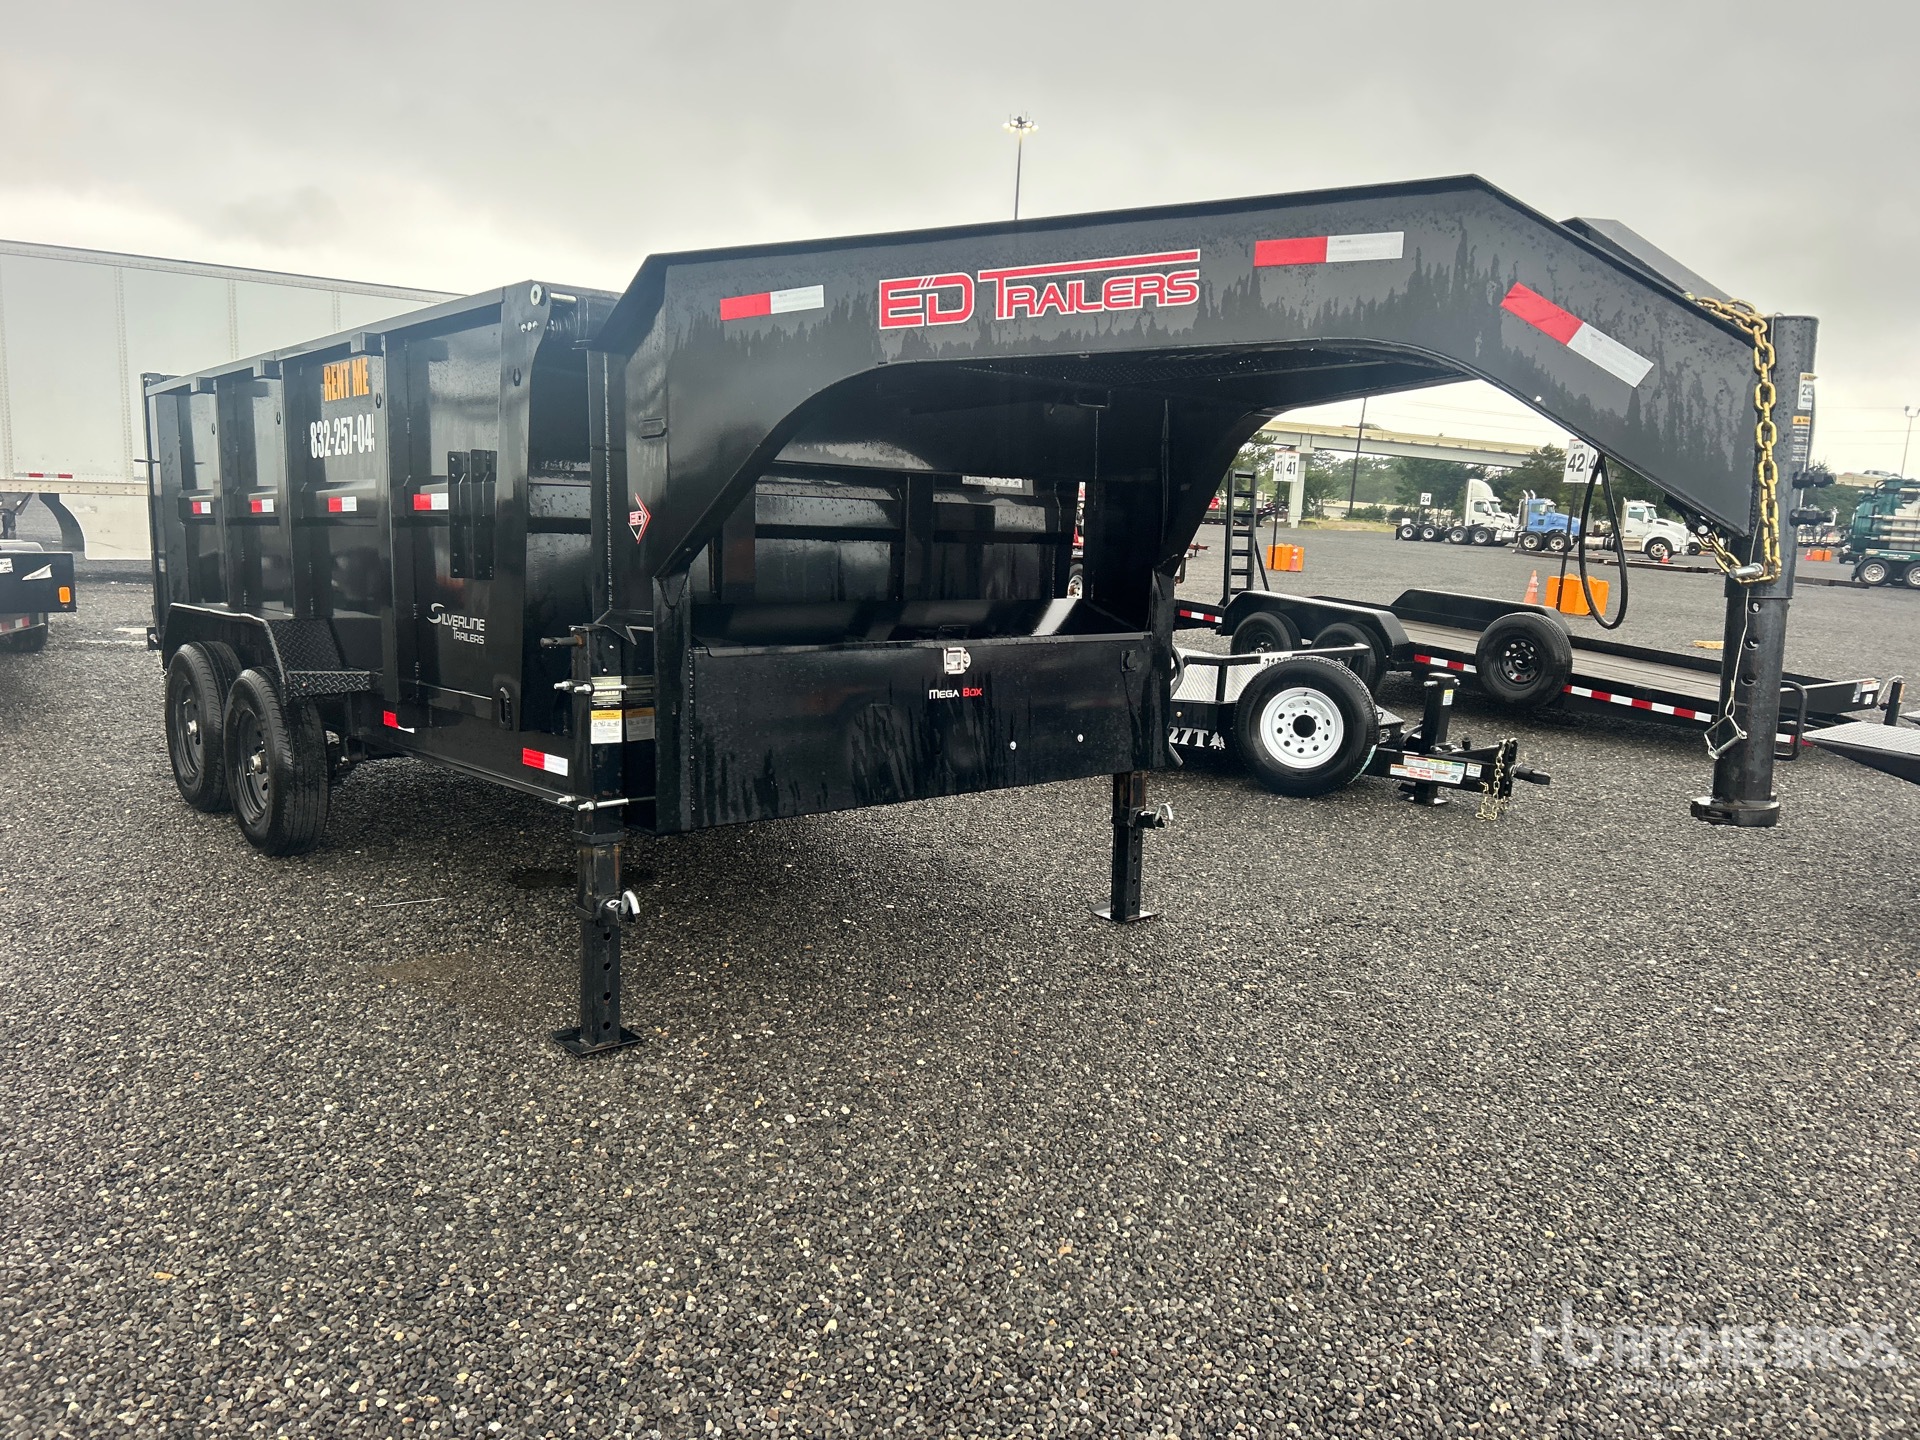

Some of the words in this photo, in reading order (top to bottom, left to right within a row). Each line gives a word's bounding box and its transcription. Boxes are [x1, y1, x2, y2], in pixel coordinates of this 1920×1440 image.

[878, 272, 975, 330] ED
[978, 248, 1201, 320] TRAILERS
[323, 361, 350, 402] RENT
[352, 357, 370, 397] ME
[310, 413, 375, 459] 832-257-04
[1275, 460, 1283, 475] 41
[1286, 461, 1297, 475] 41
[1567, 452, 1586, 473] 42
[426, 602, 486, 632] SILVERLINE
[452, 626, 485, 645] TRAILERS
[928, 689, 960, 700] MEGA
[962, 687, 983, 697] BOX
